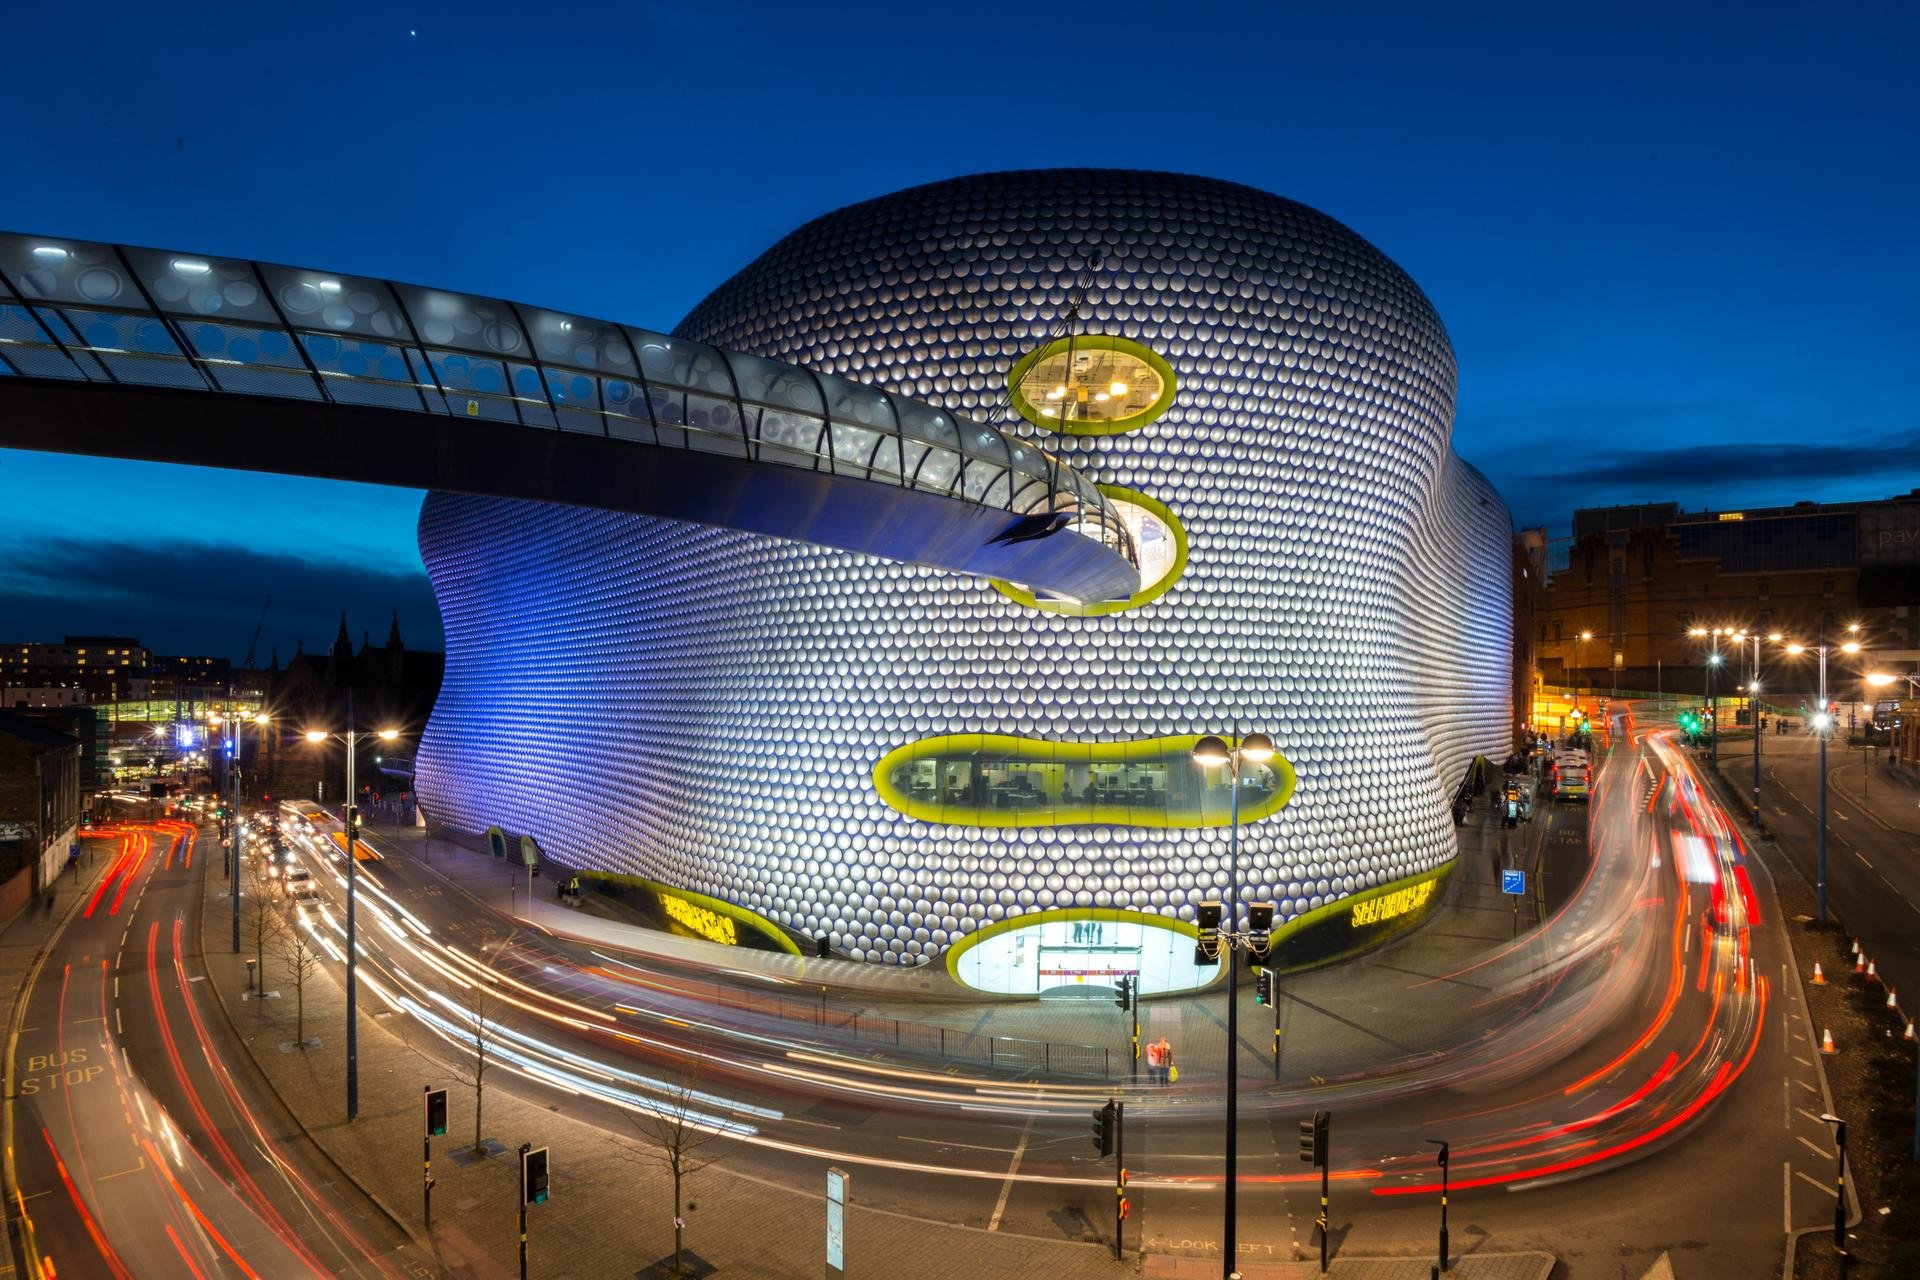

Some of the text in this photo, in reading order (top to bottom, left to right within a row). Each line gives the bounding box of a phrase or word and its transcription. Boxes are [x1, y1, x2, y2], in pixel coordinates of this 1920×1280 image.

[28, 1048, 87, 1072] BUS
[21, 1066, 104, 1095] STOP
[1169, 1239, 1275, 1254] LOOK EFT
